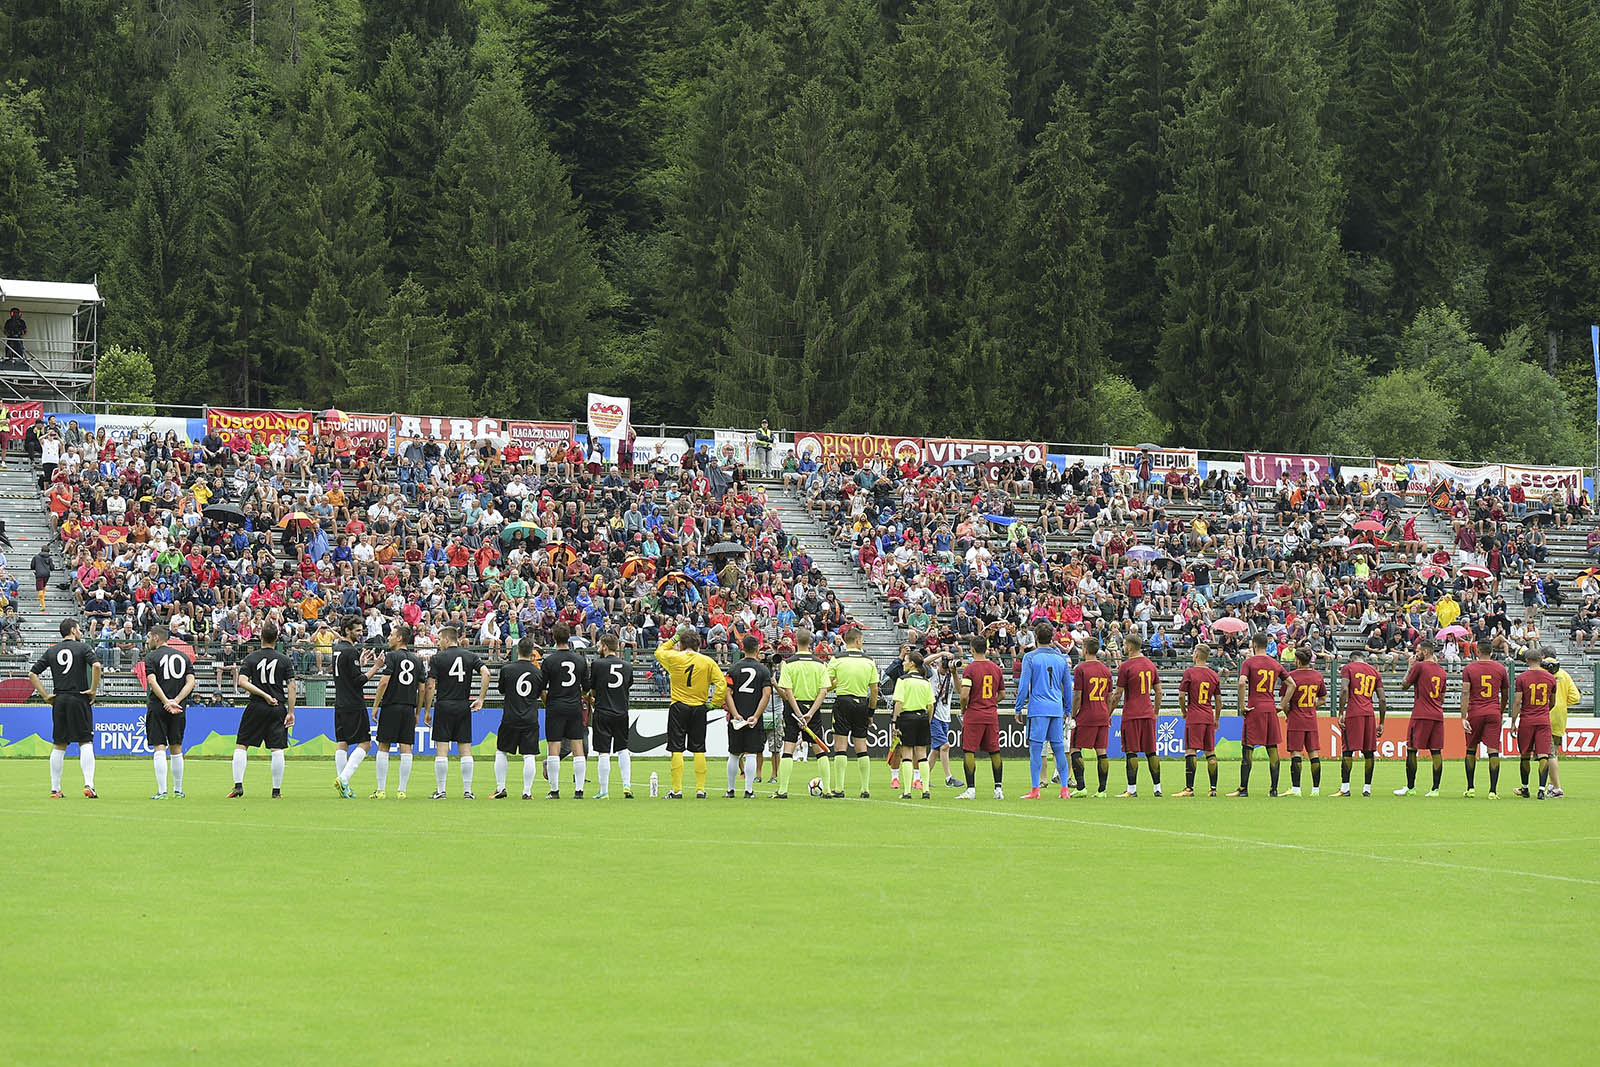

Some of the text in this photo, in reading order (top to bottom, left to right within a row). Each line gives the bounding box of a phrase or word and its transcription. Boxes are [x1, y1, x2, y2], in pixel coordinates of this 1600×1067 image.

[10, 409, 40, 419] CLUB
[209, 414, 310, 431] TUSCOLANO
[321, 418, 387, 432] LAURENTINO
[513, 428, 570, 439] RAGAZZI SIAMO
[823, 436, 892, 457] PISTOIA
[1166, 455, 1189, 467] PINI
[1521, 473, 1578, 488] SEGNI
[57, 649, 73, 674] 9
[160, 654, 186, 680] 10
[257, 658, 278, 684] 11
[333, 651, 342, 677] 7
[398, 659, 415, 685] 8
[449, 656, 466, 682] 4
[516, 672, 532, 697] 6
[561, 661, 577, 687] 3
[607, 664, 624, 688] 5
[684, 664, 695, 687] 1
[738, 667, 756, 693] 2
[1047, 666, 1053, 689] 1
[1139, 671, 1151, 694] 11
[1256, 669, 1274, 693] 21
[1354, 672, 1376, 697] 30
[982, 675, 993, 699] 8
[1089, 677, 1108, 701] 22
[1198, 681, 1210, 704] 6
[1298, 685, 1319, 708] 26
[1429, 676, 1441, 699] 3
[1480, 675, 1492, 697] 5
[1528, 683, 1548, 706] 13
[95, 723, 135, 731] RENDENA
